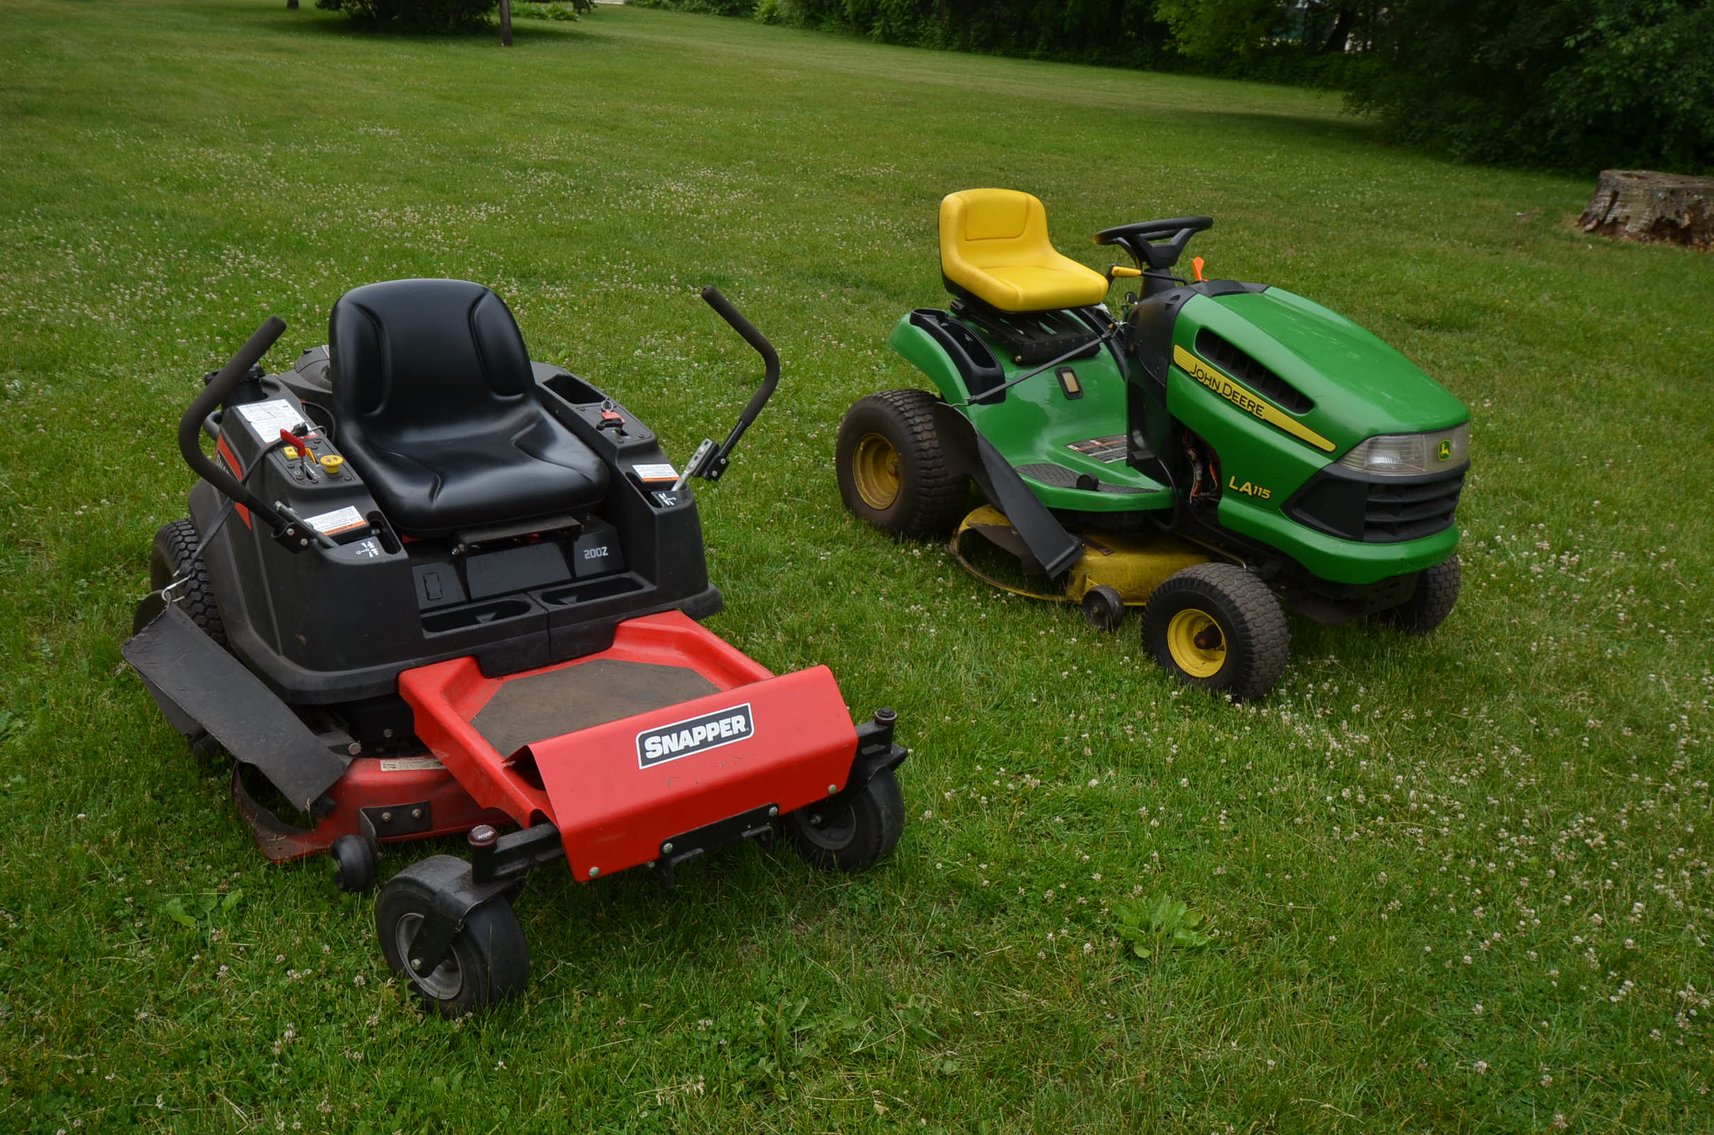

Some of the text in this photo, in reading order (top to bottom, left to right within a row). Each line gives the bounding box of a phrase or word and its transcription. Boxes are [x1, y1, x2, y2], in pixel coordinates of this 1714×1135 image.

[1189, 364, 1265, 417] JOHN DEERE
[1228, 475, 1272, 499] LA115
[583, 546, 609, 559] 200Z
[644, 714, 747, 759] SNAPPER
